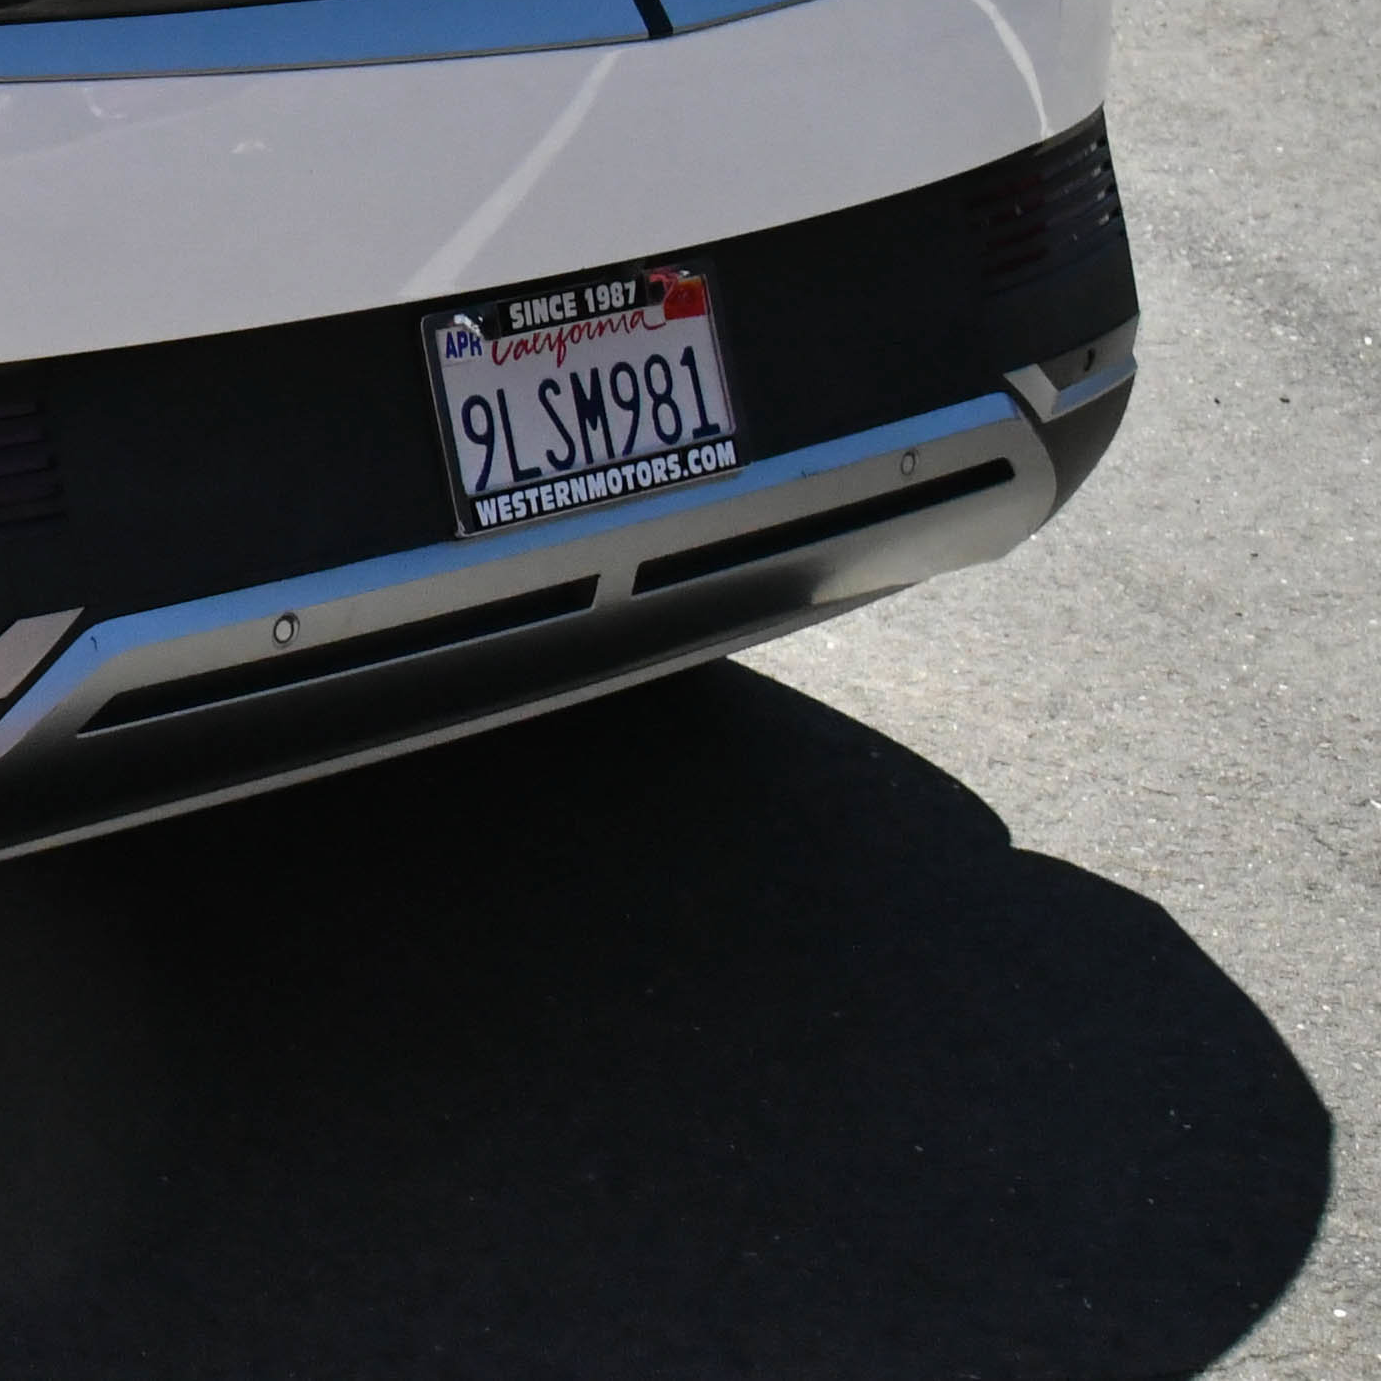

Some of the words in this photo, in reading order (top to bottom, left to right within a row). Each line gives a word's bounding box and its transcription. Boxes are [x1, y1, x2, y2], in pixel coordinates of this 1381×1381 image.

[509, 291, 577, 330] SINCE
[585, 280, 637, 313] 1987
[460, 345, 721, 492] 9LSM981
[475, 440, 736, 527] WESTERNMOTORS.COM
